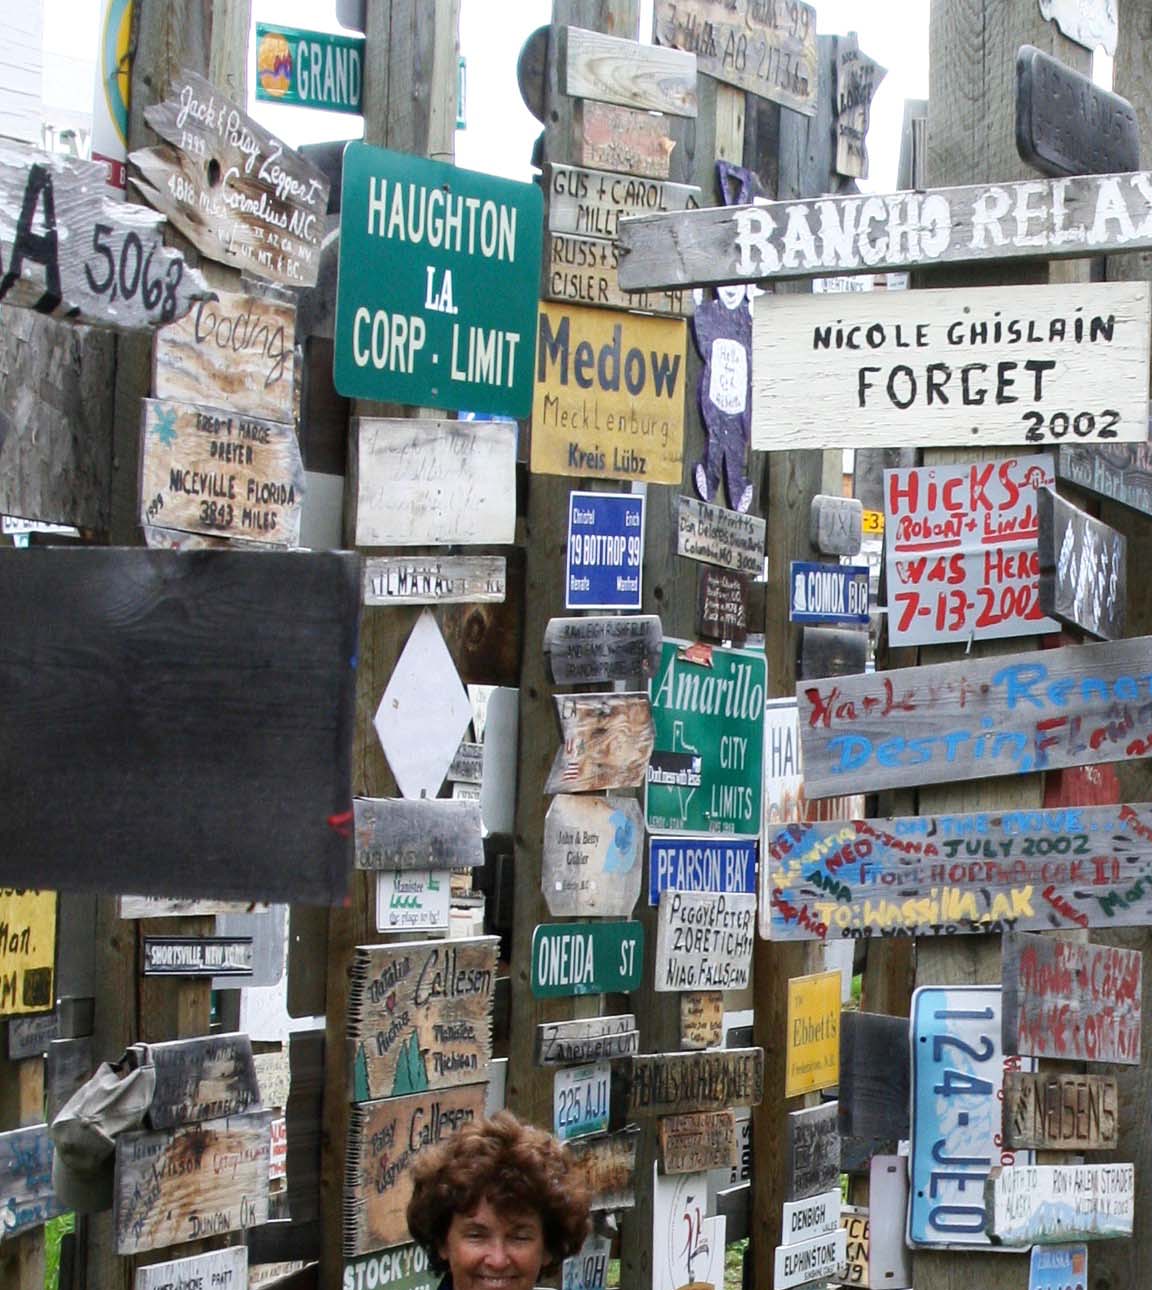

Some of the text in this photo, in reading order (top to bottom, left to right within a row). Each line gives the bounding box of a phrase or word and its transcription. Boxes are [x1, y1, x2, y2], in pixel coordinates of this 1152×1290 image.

[297, 40, 361, 107] GRAND
[552, 171, 667, 211] GUS CAROL
[367, 177, 518, 262] HAUGHTON
[731, 196, 951, 278] RANCHO
[425, 265, 459, 315] LA.
[551, 271, 609, 303] CISLER
[450, 324, 521, 389] LIMIT
[536, 312, 683, 399] Medow
[858, 360, 1056, 409] FORGET
[1022, 410, 1121, 442] 2002
[567, 442, 648, 475] Kreis Lübz
[169, 469, 296, 506] NICEVILLE FLORIDA
[241, 509, 278, 531] MILES
[570, 534, 640, 567] 19 BOTTROP 99
[895, 553, 966, 586] WAS
[807, 571, 846, 613] COMOX
[653, 661, 763, 721] Amarillo
[719, 735, 748, 770] CITY
[711, 784, 753, 820] LIMITS
[943, 833, 1093, 858] JULY 2002
[657, 849, 749, 894] PEARSON BAY
[205, 946, 224, 965] NEW
[536, 934, 637, 986] ONEIDA ST
[792, 1007, 838, 1049] Ebbett's
[558, 1085, 582, 1128] 225
[791, 1203, 826, 1233] DENBIGH
[784, 1241, 836, 1277] ELPHINSTONE
